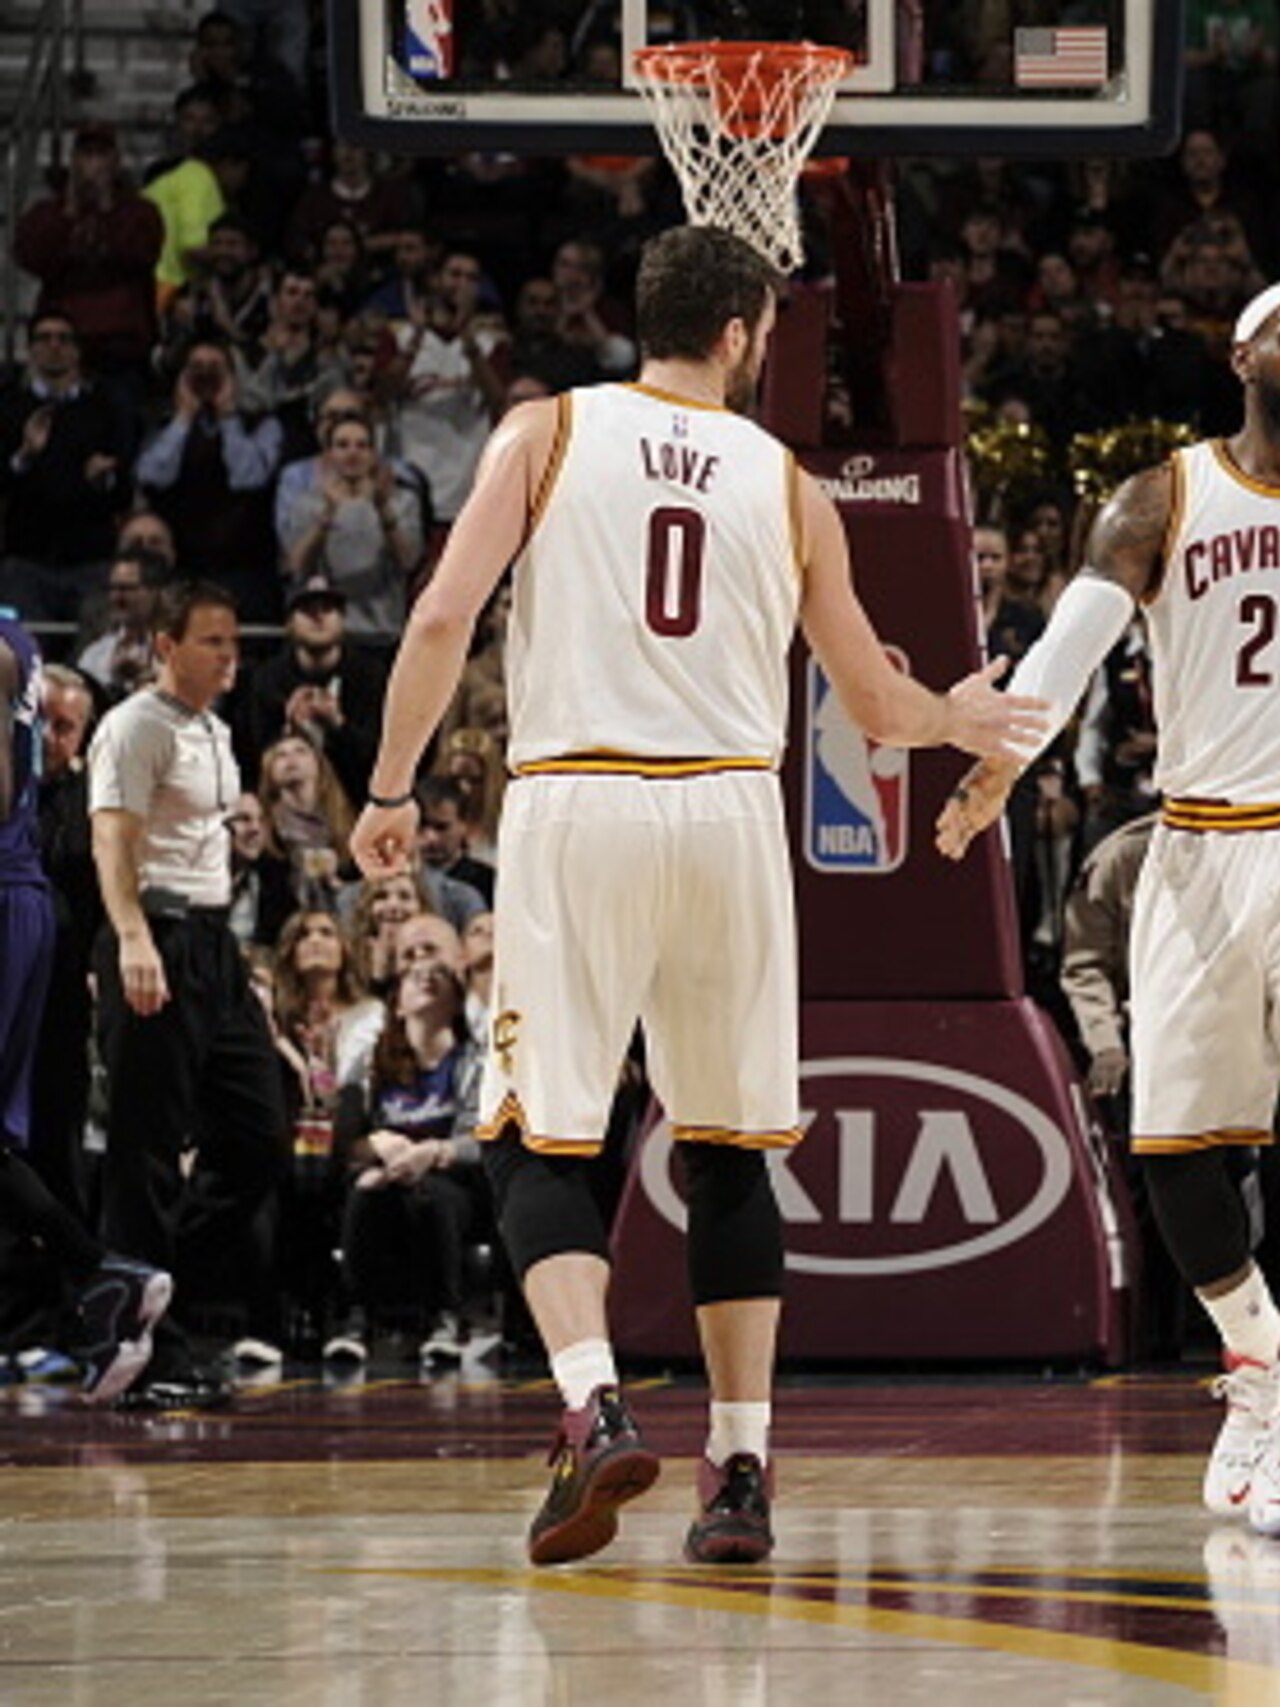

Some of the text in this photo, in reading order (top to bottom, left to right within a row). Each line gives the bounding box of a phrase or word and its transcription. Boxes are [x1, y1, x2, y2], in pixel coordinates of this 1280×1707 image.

[640, 437, 720, 494] LOVE
[816, 474, 920, 504] PALDING
[645, 506, 706, 637] 0
[818, 824, 872, 855] NBA
